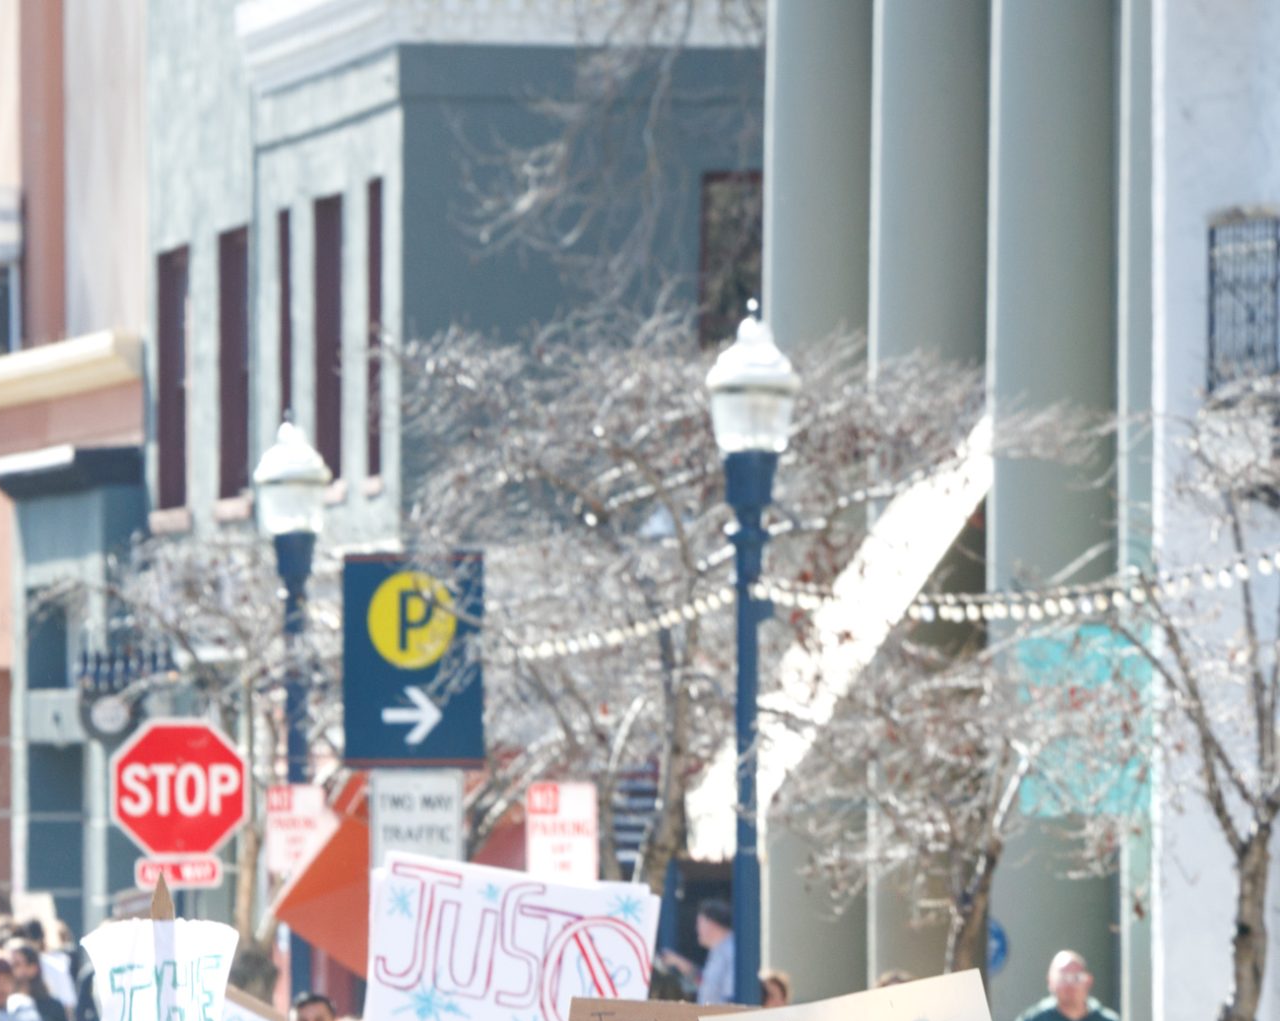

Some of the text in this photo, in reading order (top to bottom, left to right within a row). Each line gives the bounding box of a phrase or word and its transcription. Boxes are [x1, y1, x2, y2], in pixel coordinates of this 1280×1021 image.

[398, 589, 433, 653] P
[120, 763, 240, 817] STOP
[380, 792, 453, 811] TWO WAY
[382, 824, 452, 844] TRAFFIC
